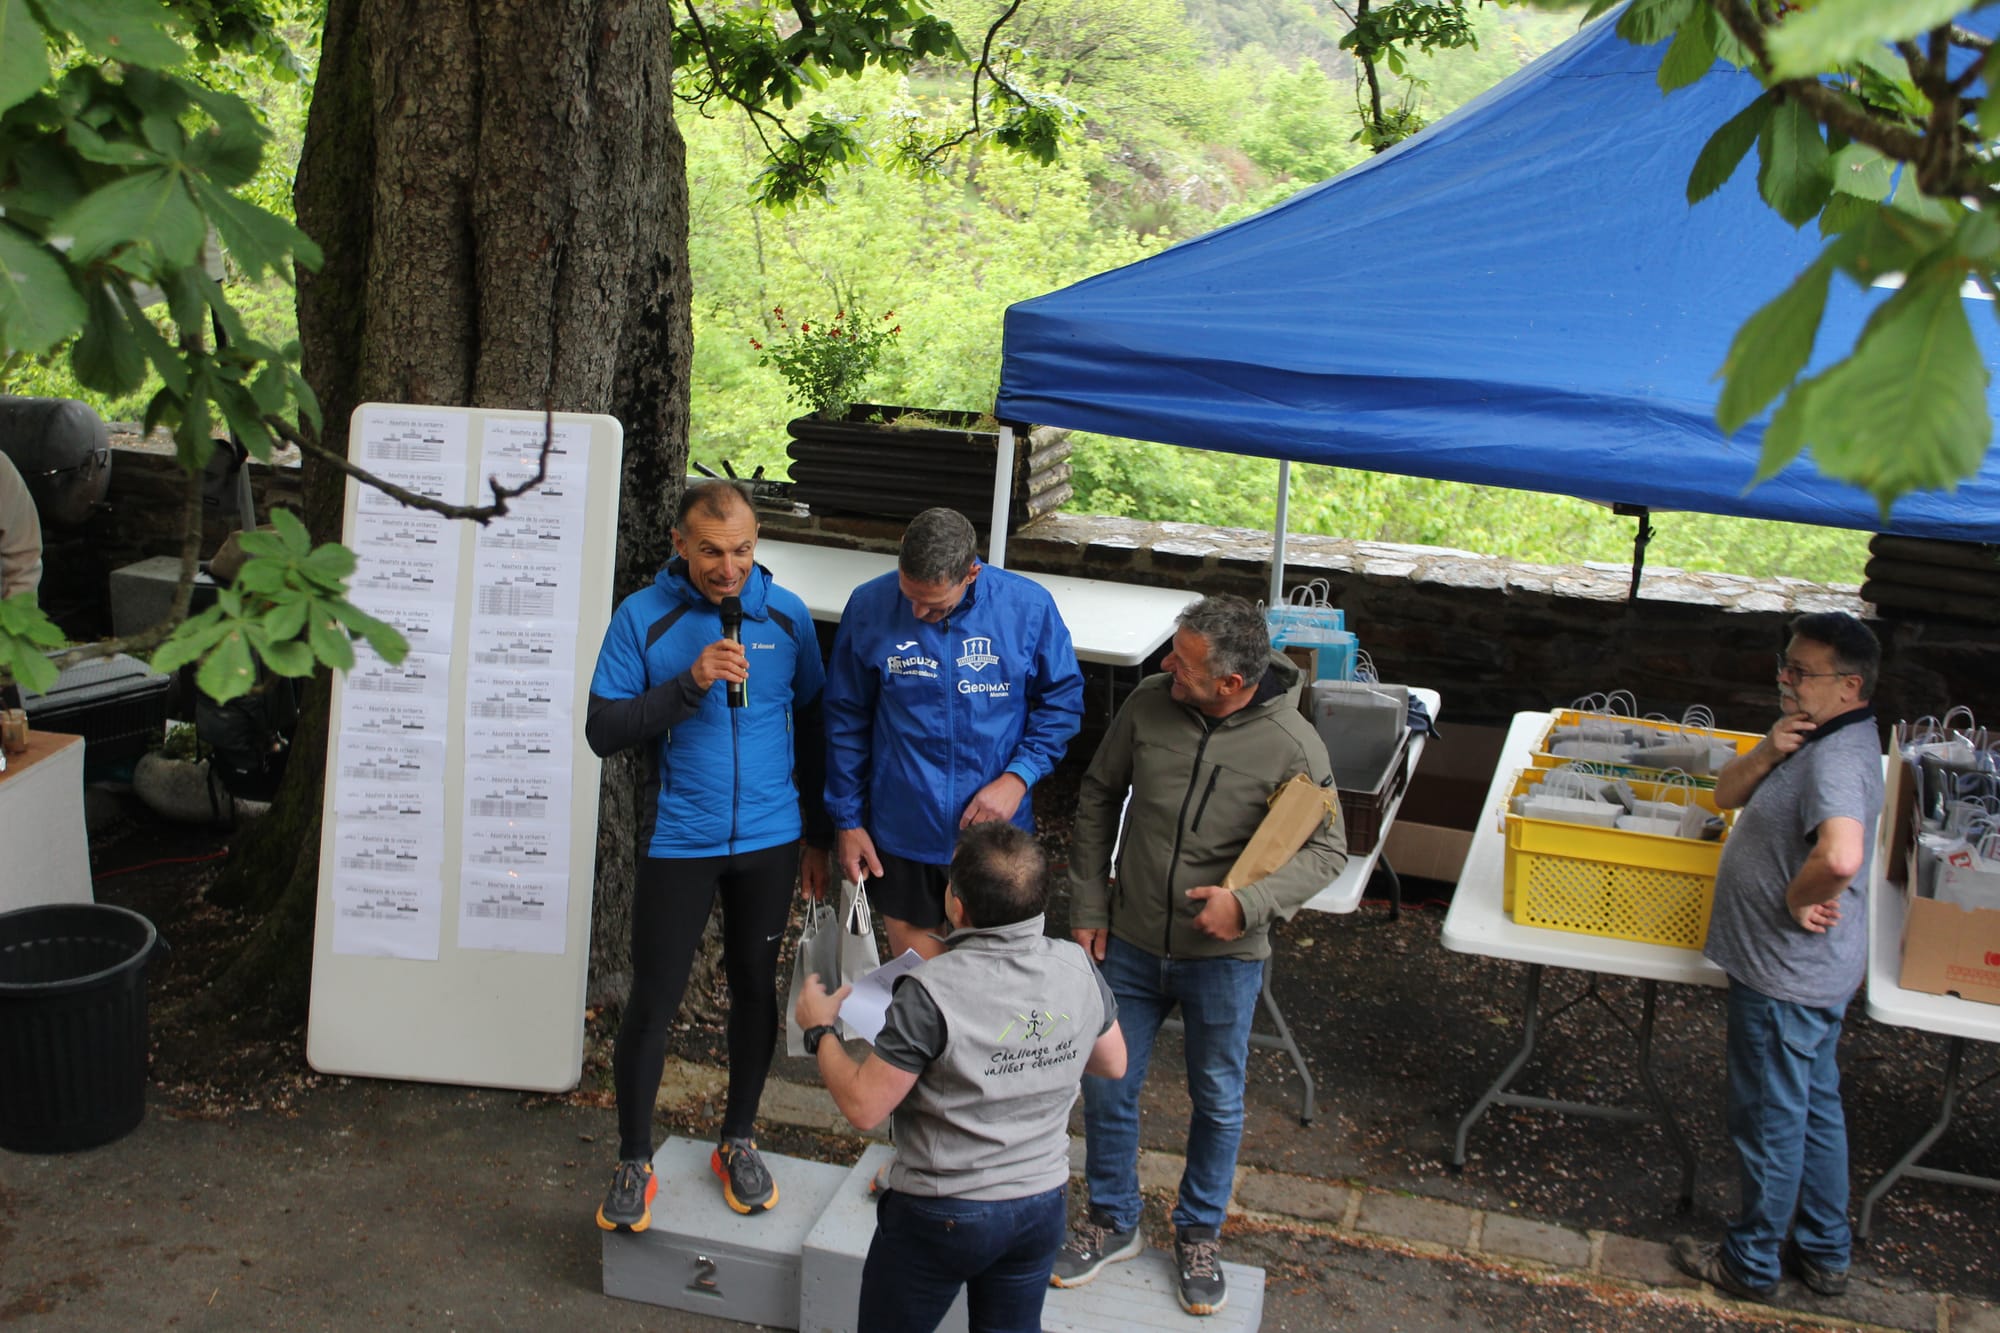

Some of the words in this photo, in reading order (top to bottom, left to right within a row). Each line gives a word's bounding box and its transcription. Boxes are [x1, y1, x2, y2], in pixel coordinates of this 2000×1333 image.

[991, 1046, 1048, 1062] Challenge
[1055, 1040, 1072, 1051] des
[984, 1062, 1024, 1076] vallées
[695, 1255, 717, 1288] 2
